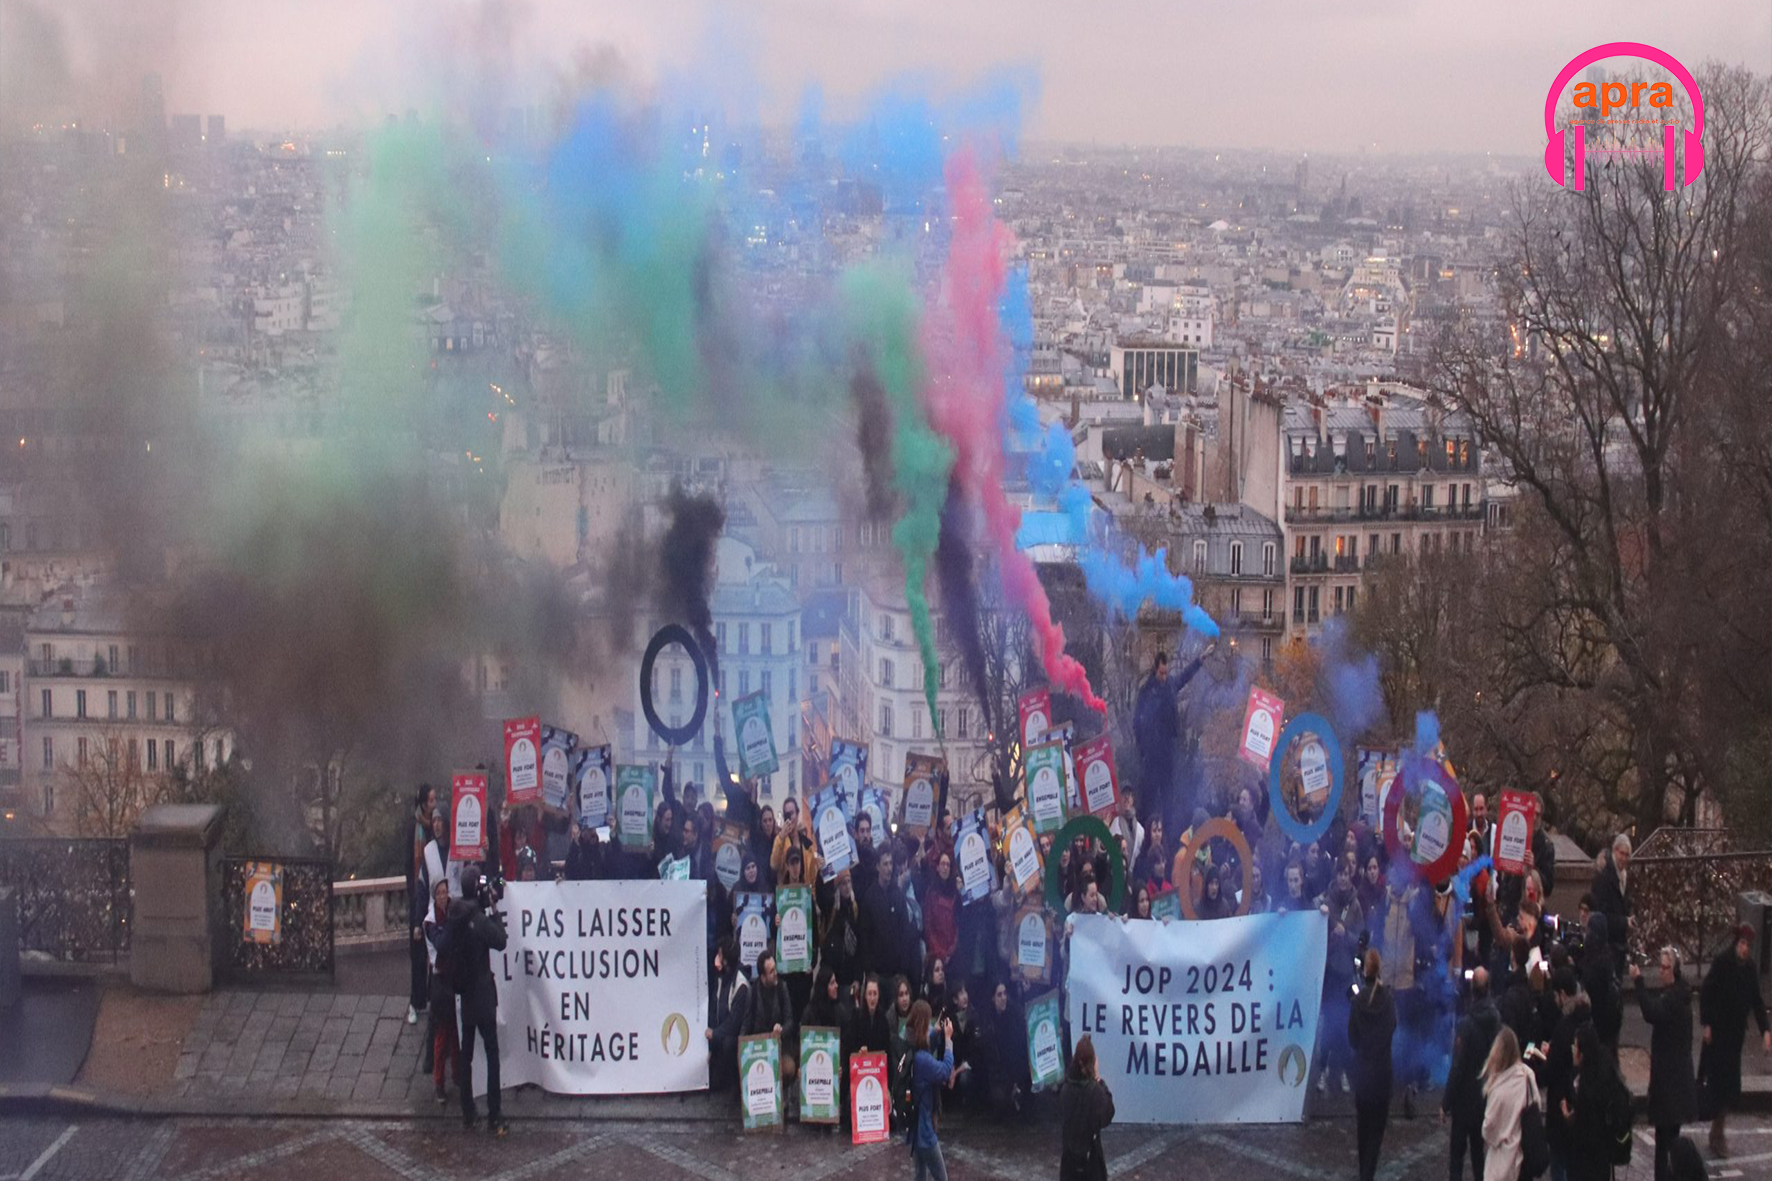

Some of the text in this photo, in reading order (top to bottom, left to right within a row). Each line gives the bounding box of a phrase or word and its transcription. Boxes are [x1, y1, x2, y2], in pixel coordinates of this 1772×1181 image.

[522, 908, 564, 938] PAS
[578, 908, 672, 937] LAISSER
[503, 949, 659, 981] L'EXCLUSION
[1121, 959, 1274, 995] JOP 2024 :
[561, 991, 590, 1021] EN
[1081, 999, 1304, 1036] LE REVERS DE LA
[527, 1022, 639, 1062] HÉRITAGE
[1126, 1038, 1268, 1077] MEDAILLE
